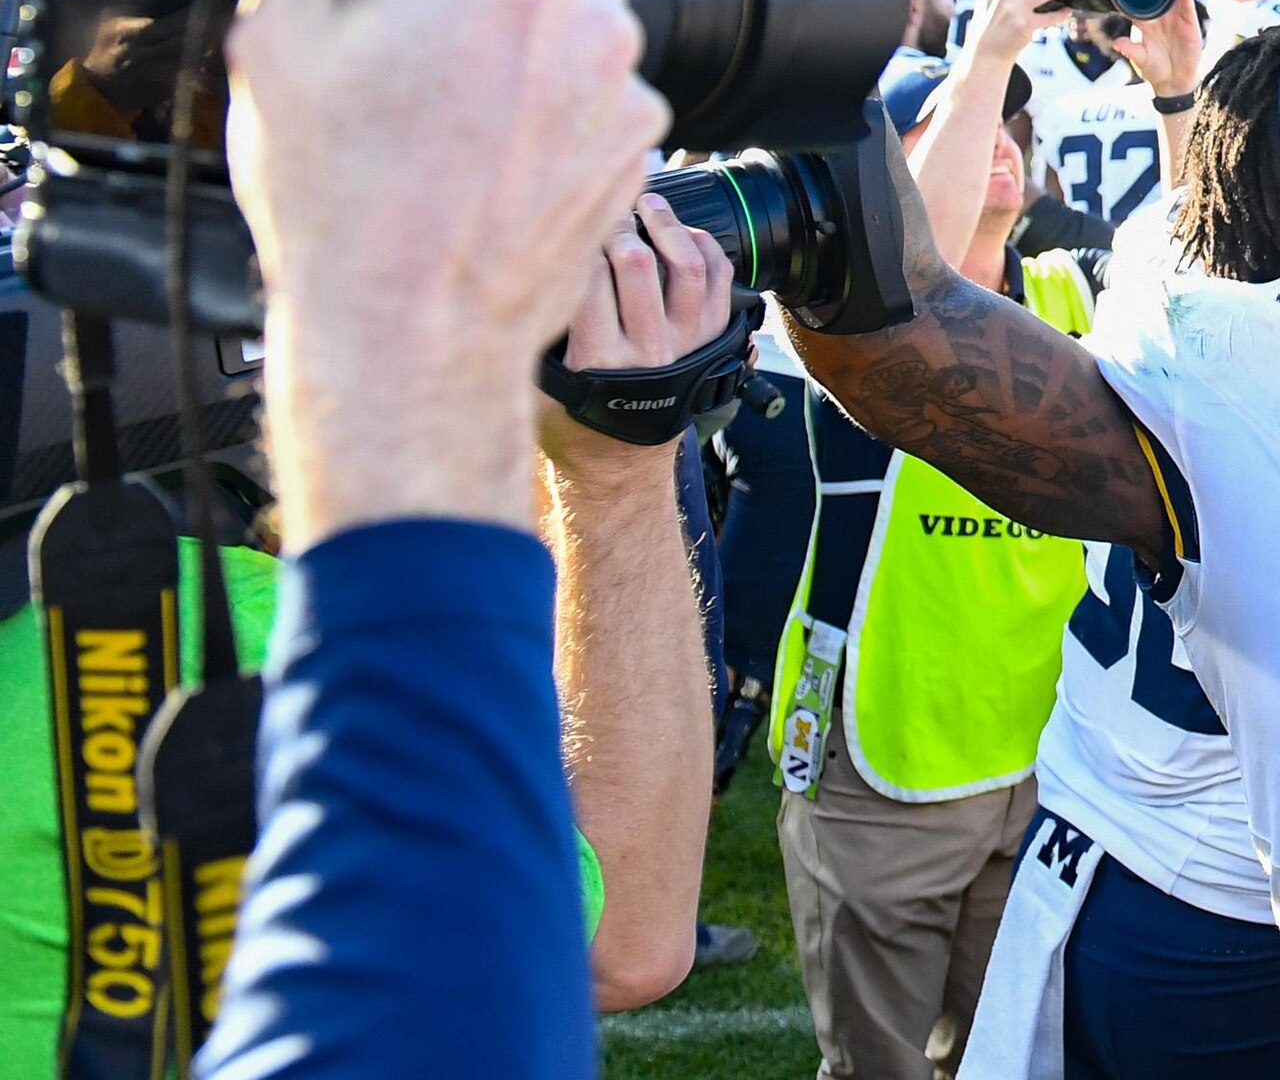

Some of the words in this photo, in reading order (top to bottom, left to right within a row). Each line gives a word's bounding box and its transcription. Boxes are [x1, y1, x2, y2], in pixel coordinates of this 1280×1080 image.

[1058, 129, 1162, 222] 32
[606, 395, 677, 410] Canon
[75, 629, 150, 814] Nikon
[1036, 820, 1095, 889] M
[82, 827, 163, 1018] D750
